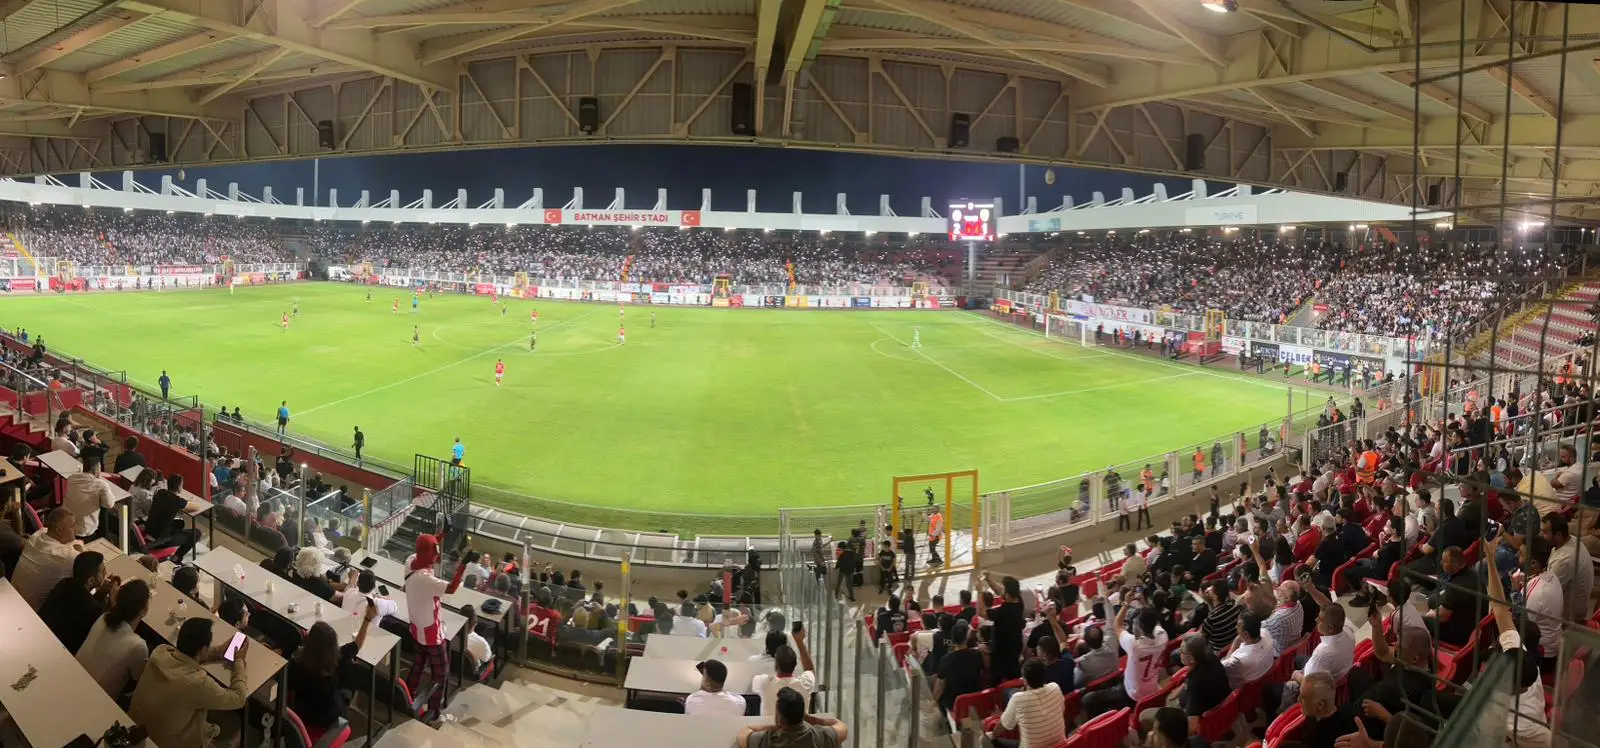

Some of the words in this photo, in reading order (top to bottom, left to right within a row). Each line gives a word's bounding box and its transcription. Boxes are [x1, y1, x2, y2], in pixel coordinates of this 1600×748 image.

[574, 212, 611, 221] BATMAN
[613, 211, 640, 222] ŞEHİR
[527, 613, 550, 636] 21
